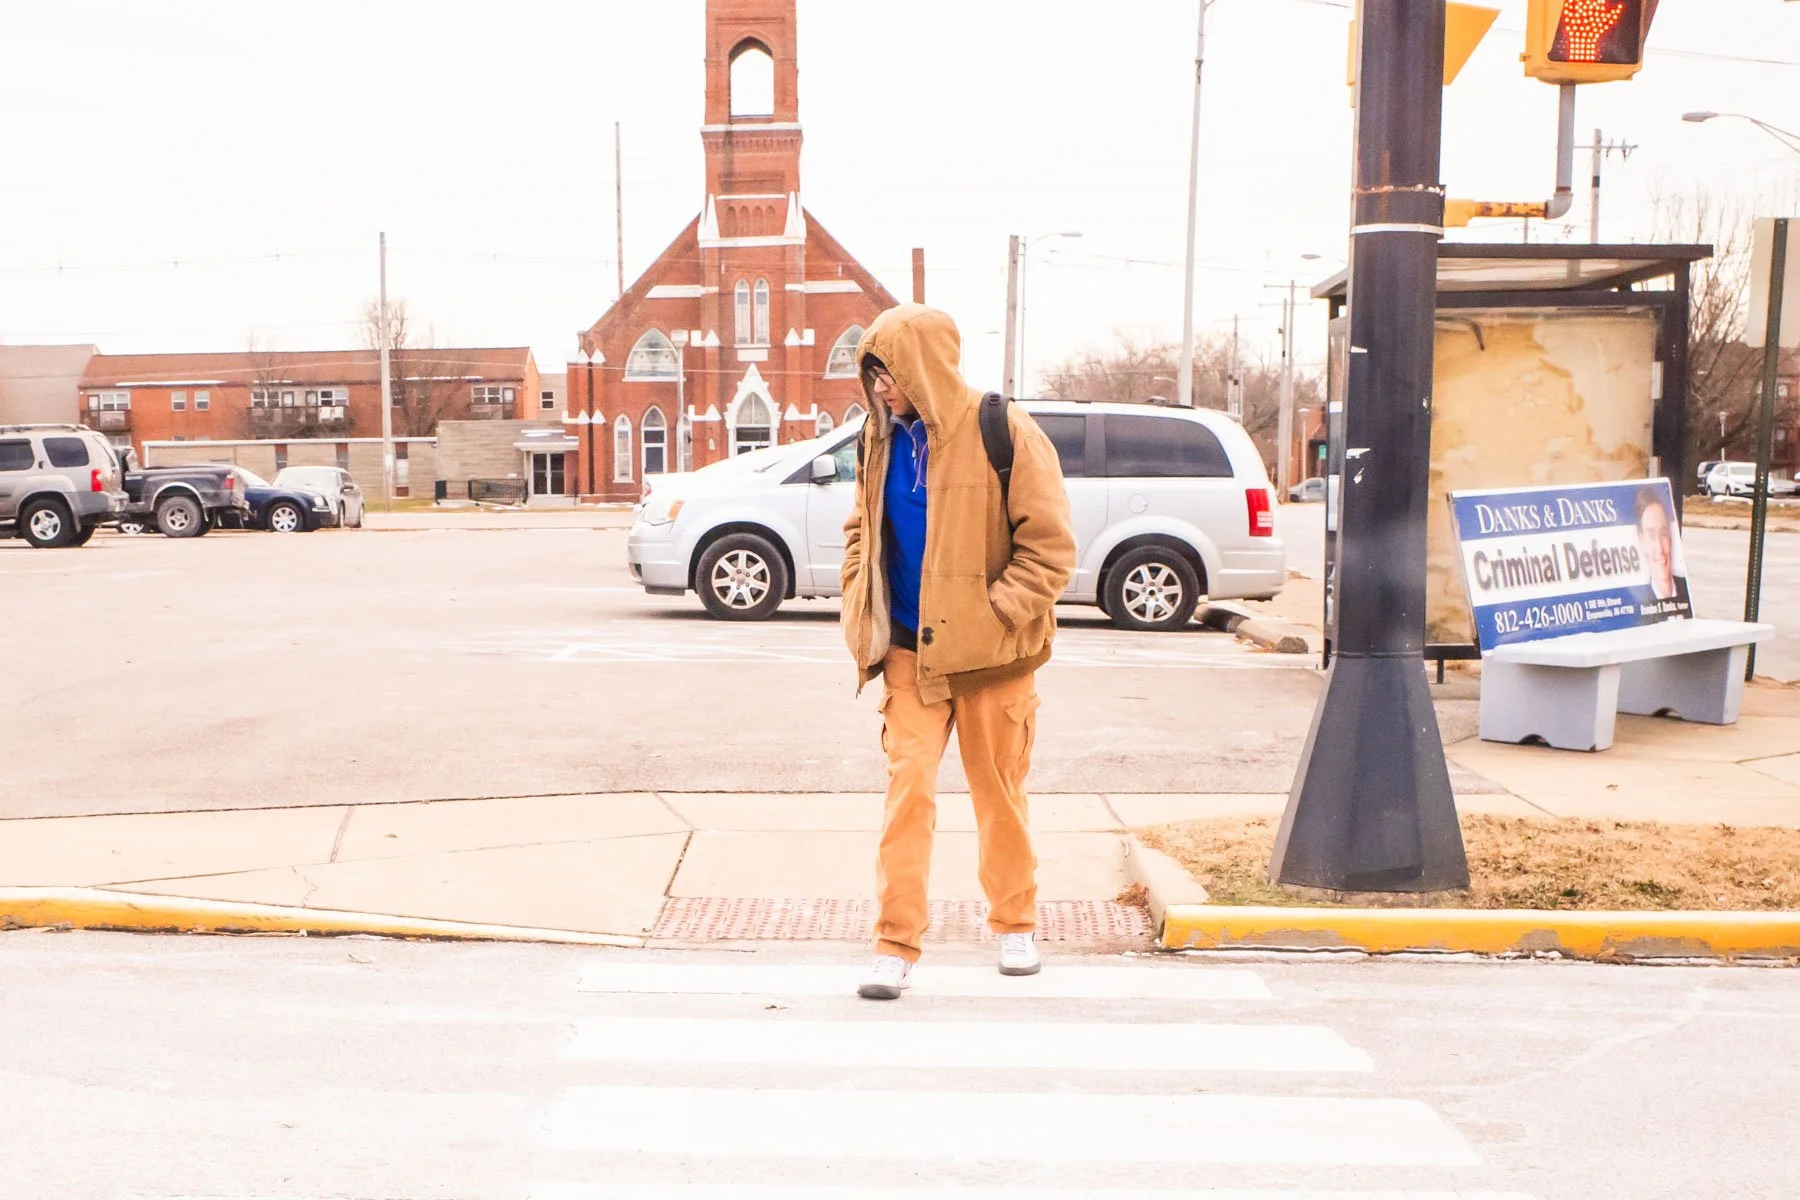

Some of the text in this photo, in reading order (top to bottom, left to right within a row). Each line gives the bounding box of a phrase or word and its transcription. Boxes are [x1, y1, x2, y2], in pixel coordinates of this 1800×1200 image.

[1474, 498, 1617, 533] DANKS & DANKS
[1473, 538, 1640, 590] Criminal Defense
[1494, 602, 1584, 633] 812-426-1000
